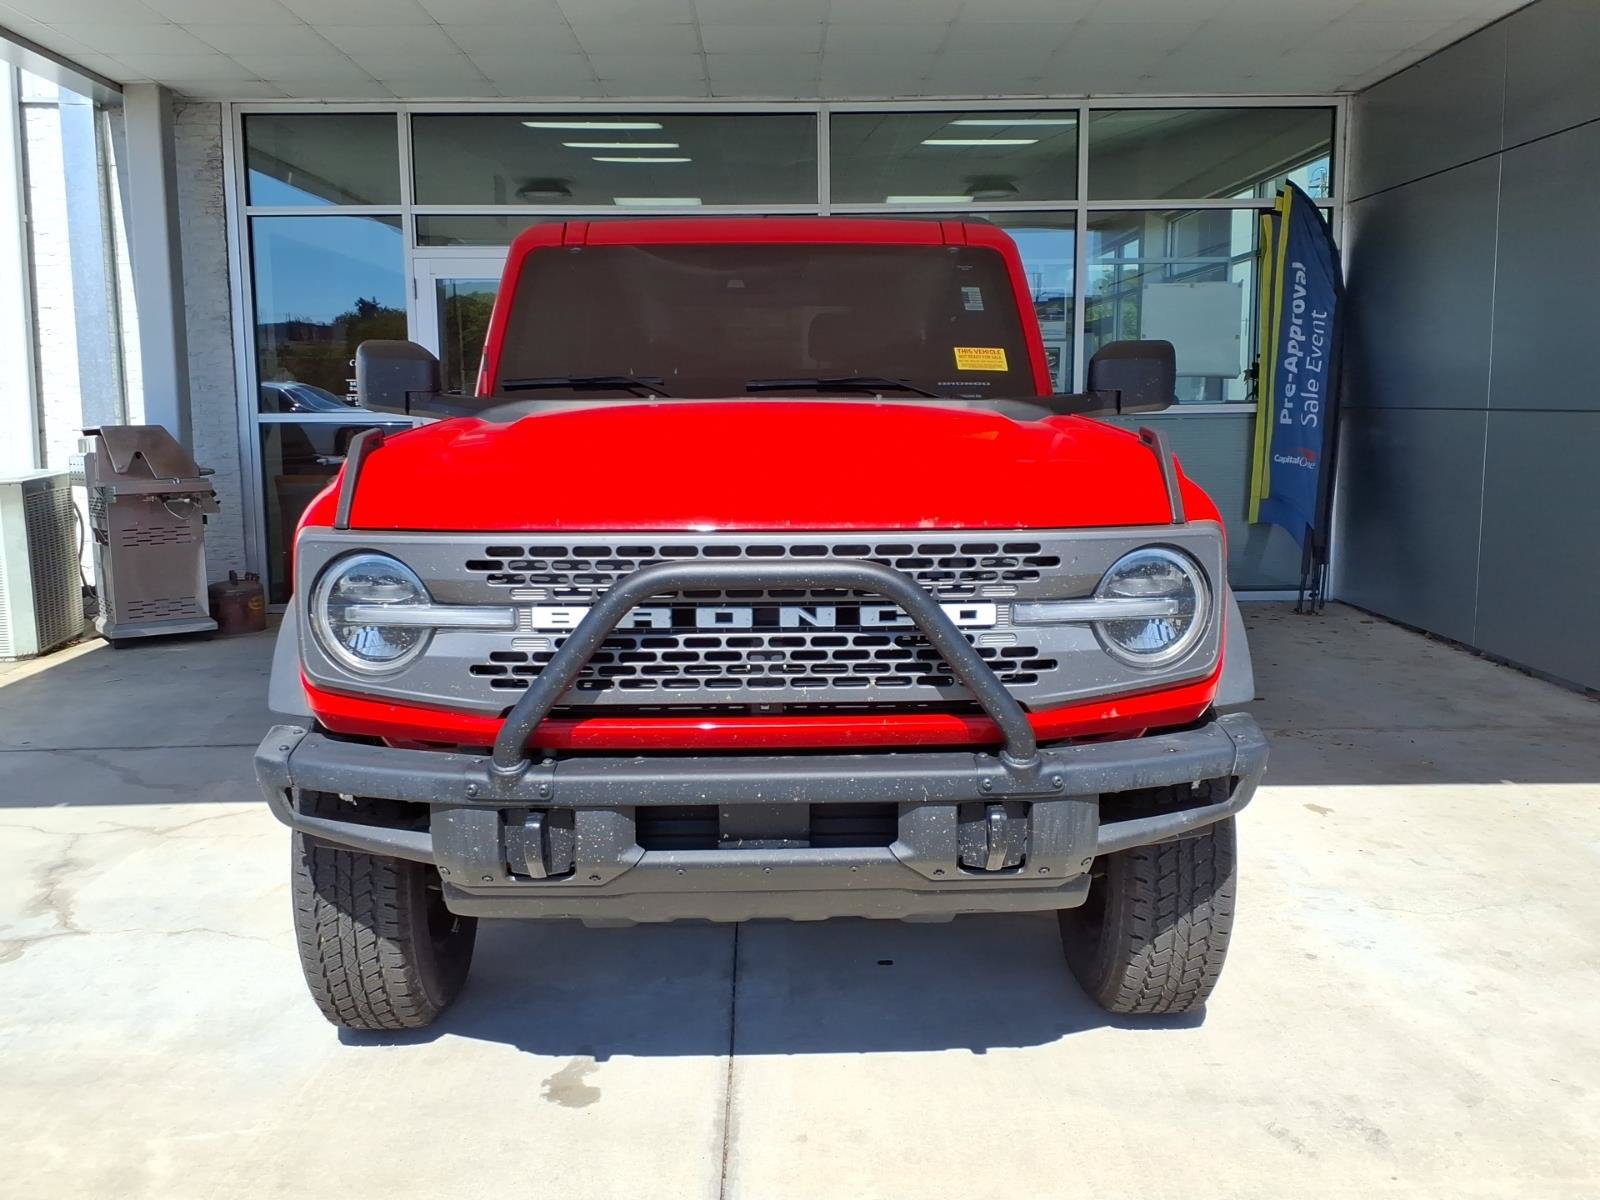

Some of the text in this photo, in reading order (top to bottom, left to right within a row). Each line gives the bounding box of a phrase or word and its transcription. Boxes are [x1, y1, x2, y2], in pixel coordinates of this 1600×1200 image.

[1279, 261, 1308, 425] Pre-Approval
[1301, 309, 1328, 428] Sale Event
[531, 603, 997, 629] BRONCO
